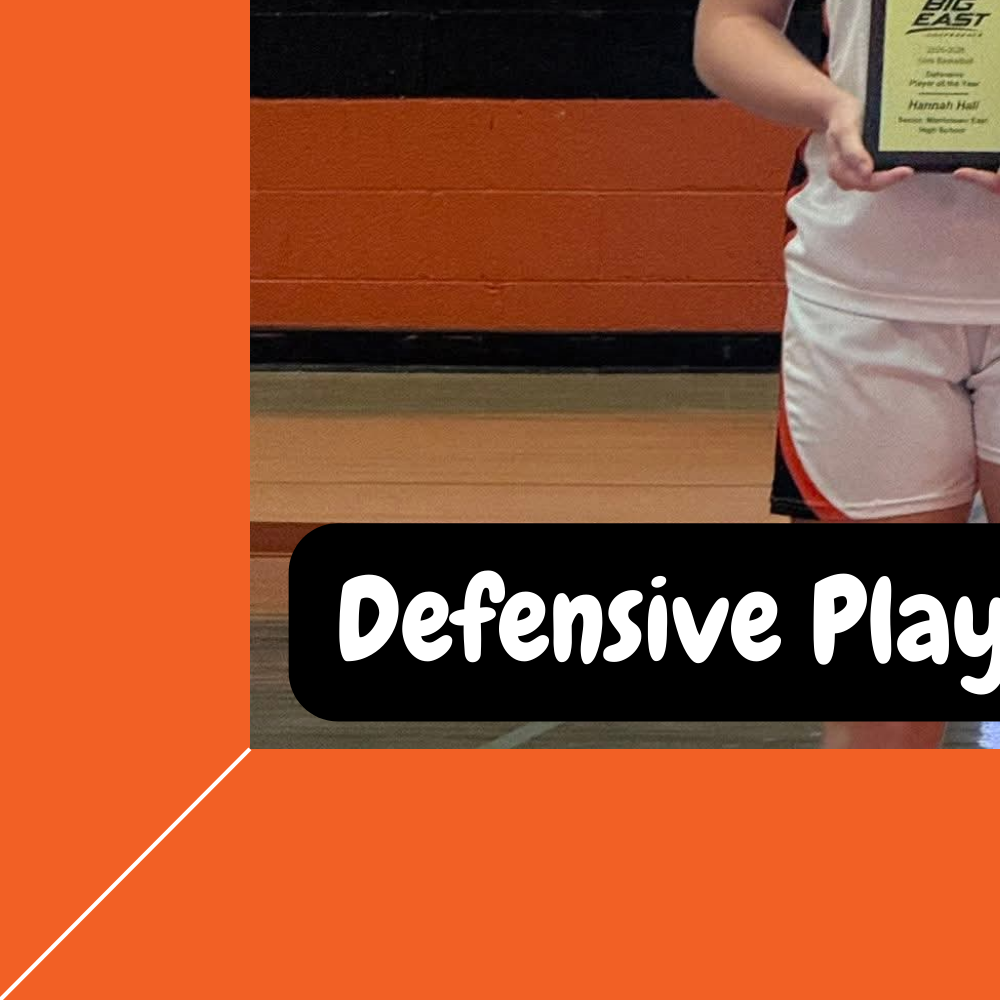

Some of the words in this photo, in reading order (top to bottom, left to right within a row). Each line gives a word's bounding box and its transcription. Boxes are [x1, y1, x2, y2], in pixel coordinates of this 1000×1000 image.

[911, 12, 992, 26] EAST
[908, 99, 954, 110] Hannah
[956, 100, 980, 110] Hall
